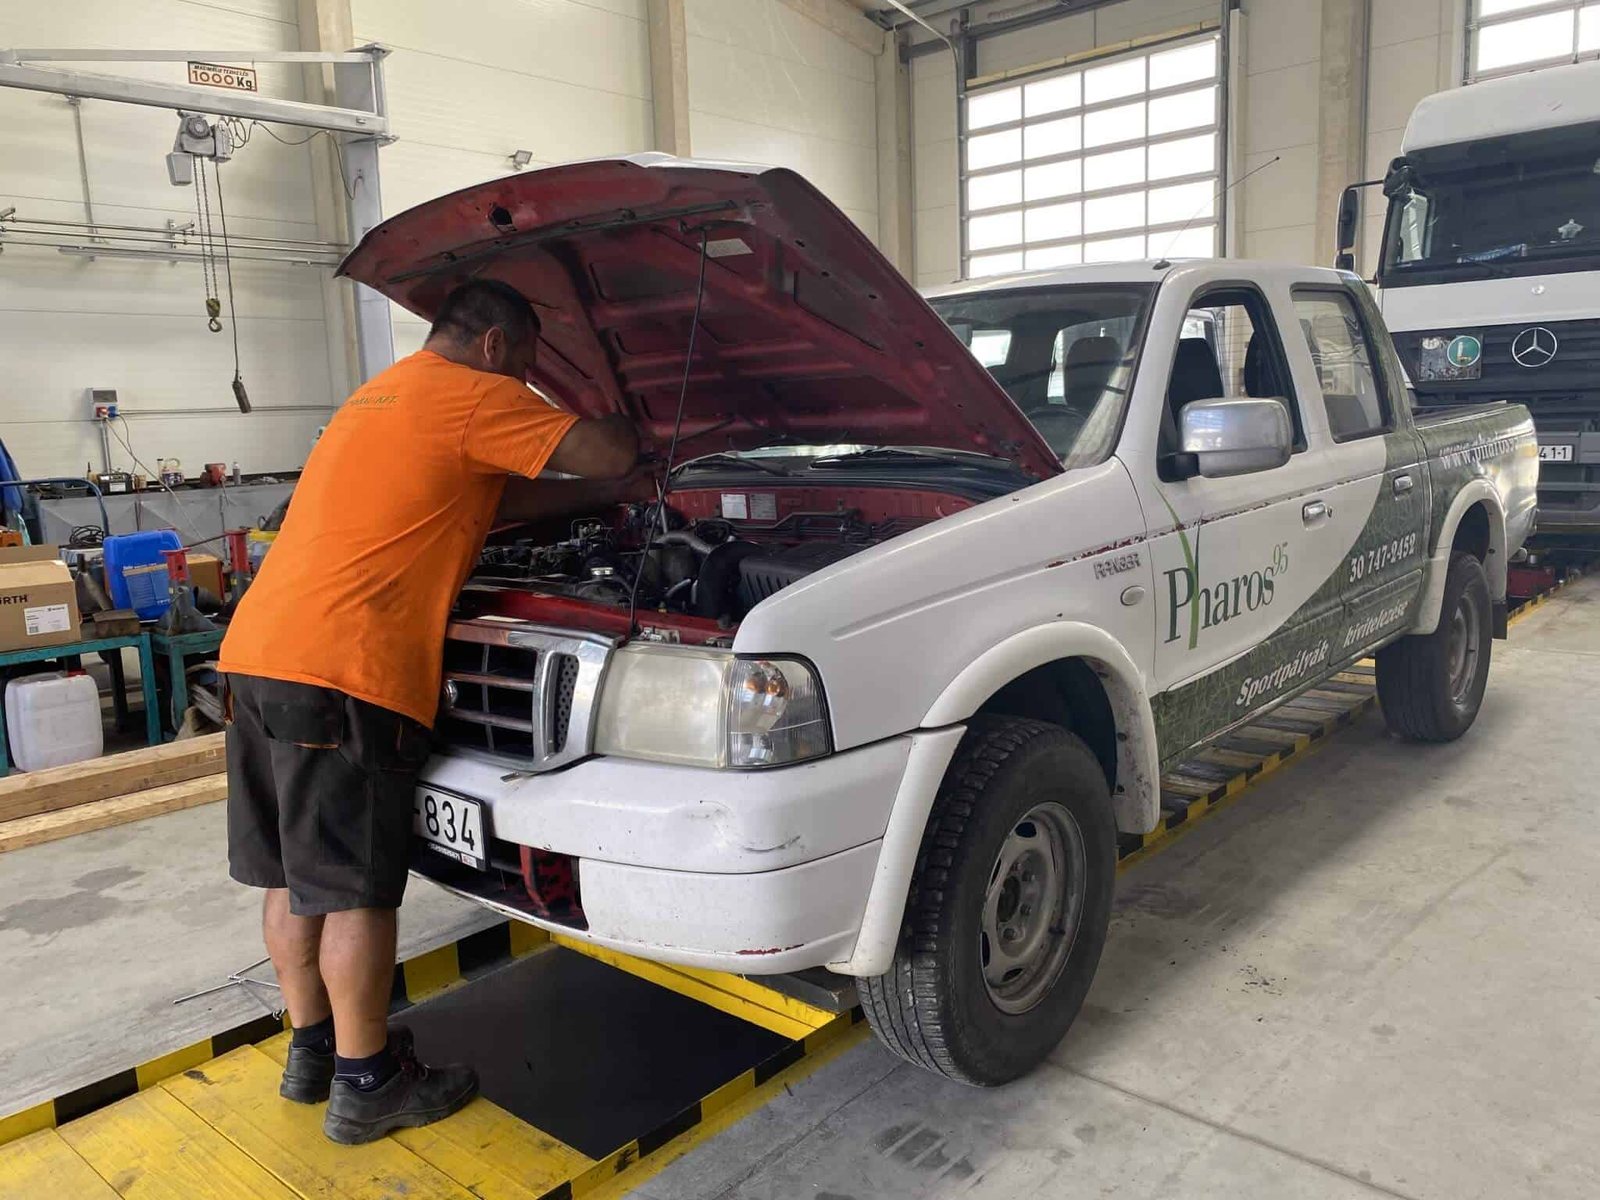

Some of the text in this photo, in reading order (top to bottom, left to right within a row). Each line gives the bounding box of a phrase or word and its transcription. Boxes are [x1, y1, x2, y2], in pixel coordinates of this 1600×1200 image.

[192, 71, 252, 90] 1000 Kg
[1349, 554, 1365, 583] 30
